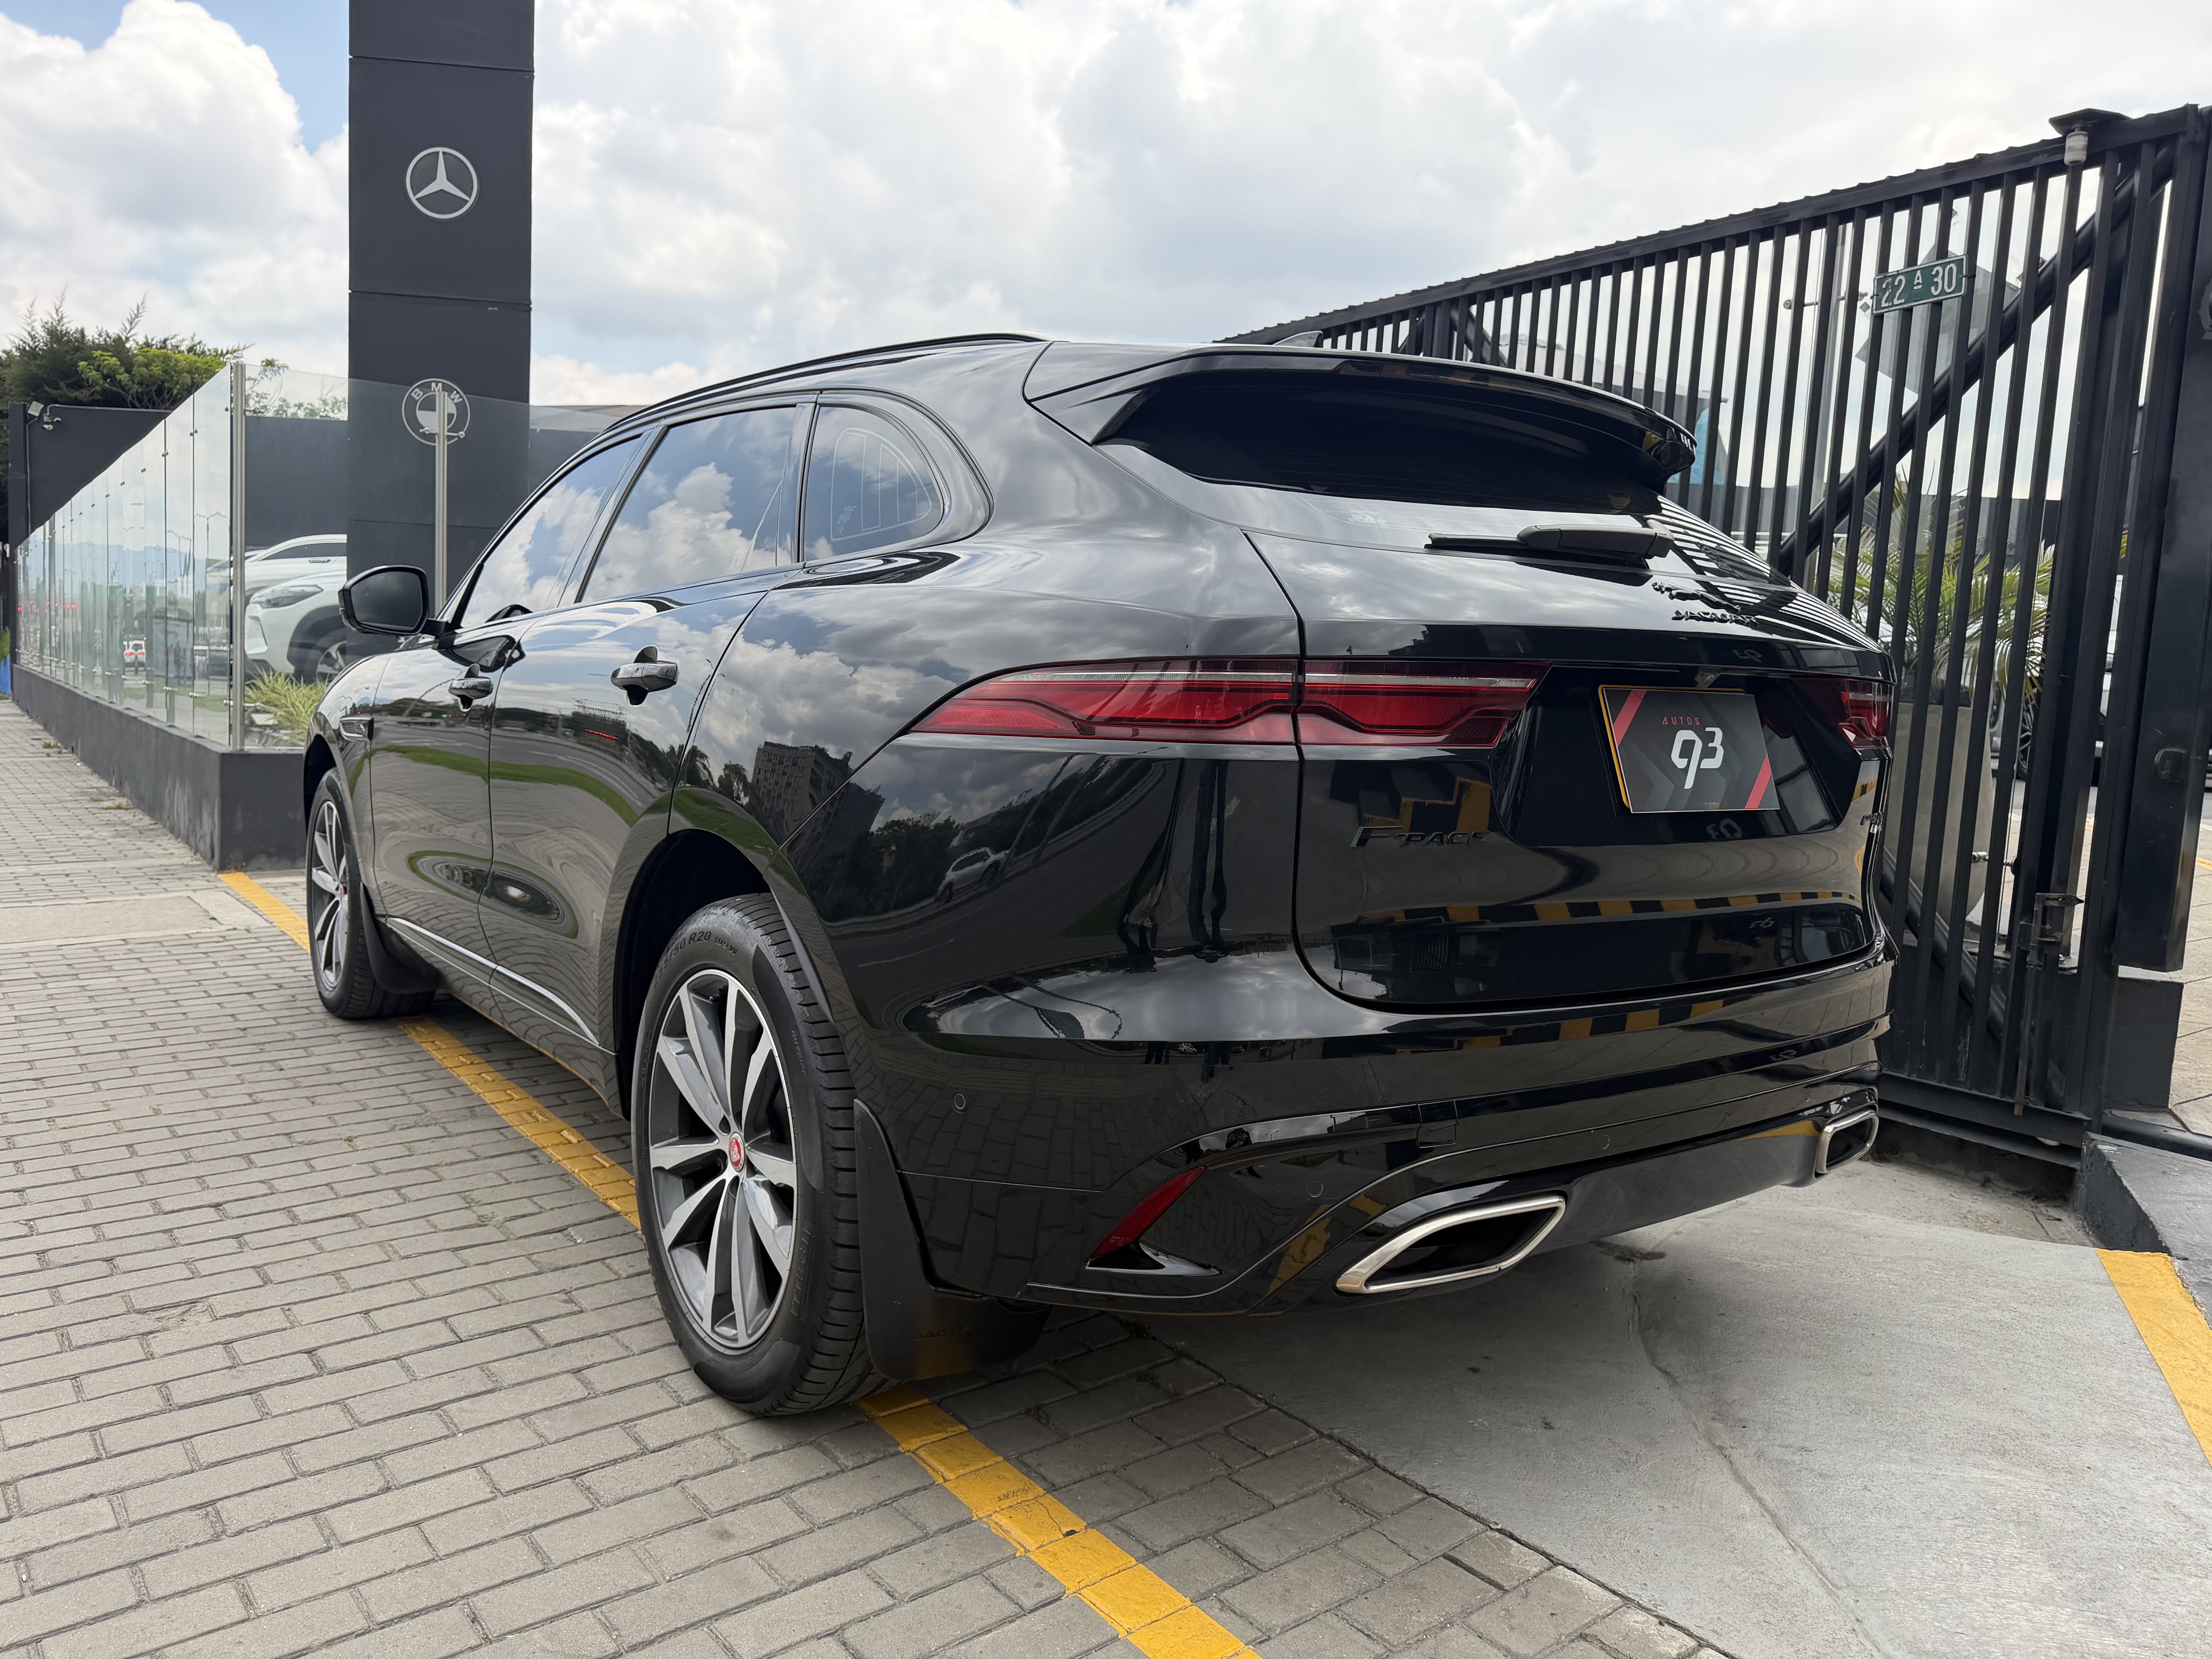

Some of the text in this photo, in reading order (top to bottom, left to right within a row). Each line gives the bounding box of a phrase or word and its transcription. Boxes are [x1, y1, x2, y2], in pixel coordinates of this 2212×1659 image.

[1881, 275, 1906, 307] 22
[1930, 263, 1957, 295] 30
[411, 382, 463, 404] BMW
[1662, 716, 1700, 726] AUTOS
[688, 931, 711, 945] R20
[714, 937, 729, 948] 109
